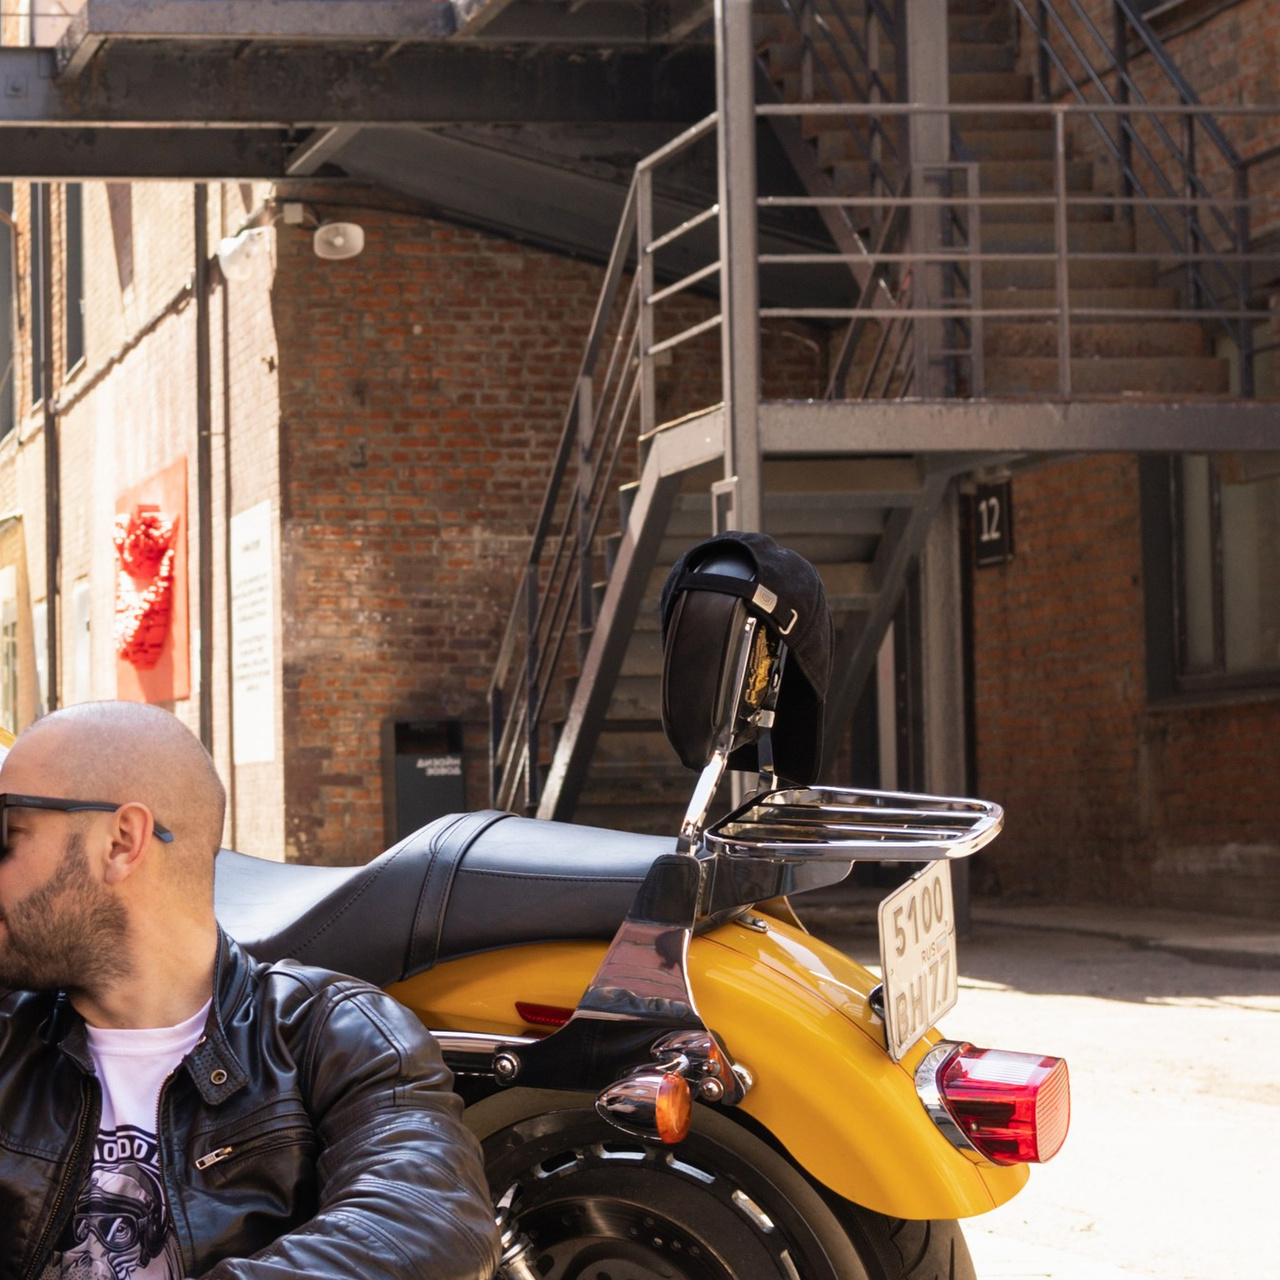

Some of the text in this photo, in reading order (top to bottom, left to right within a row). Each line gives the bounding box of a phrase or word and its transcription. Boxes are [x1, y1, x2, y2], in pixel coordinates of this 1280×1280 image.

[978, 497, 1001, 542] 12
[893, 876, 943, 957] 5100
[921, 941, 936, 964] RUS
[928, 949, 951, 1015] 77
